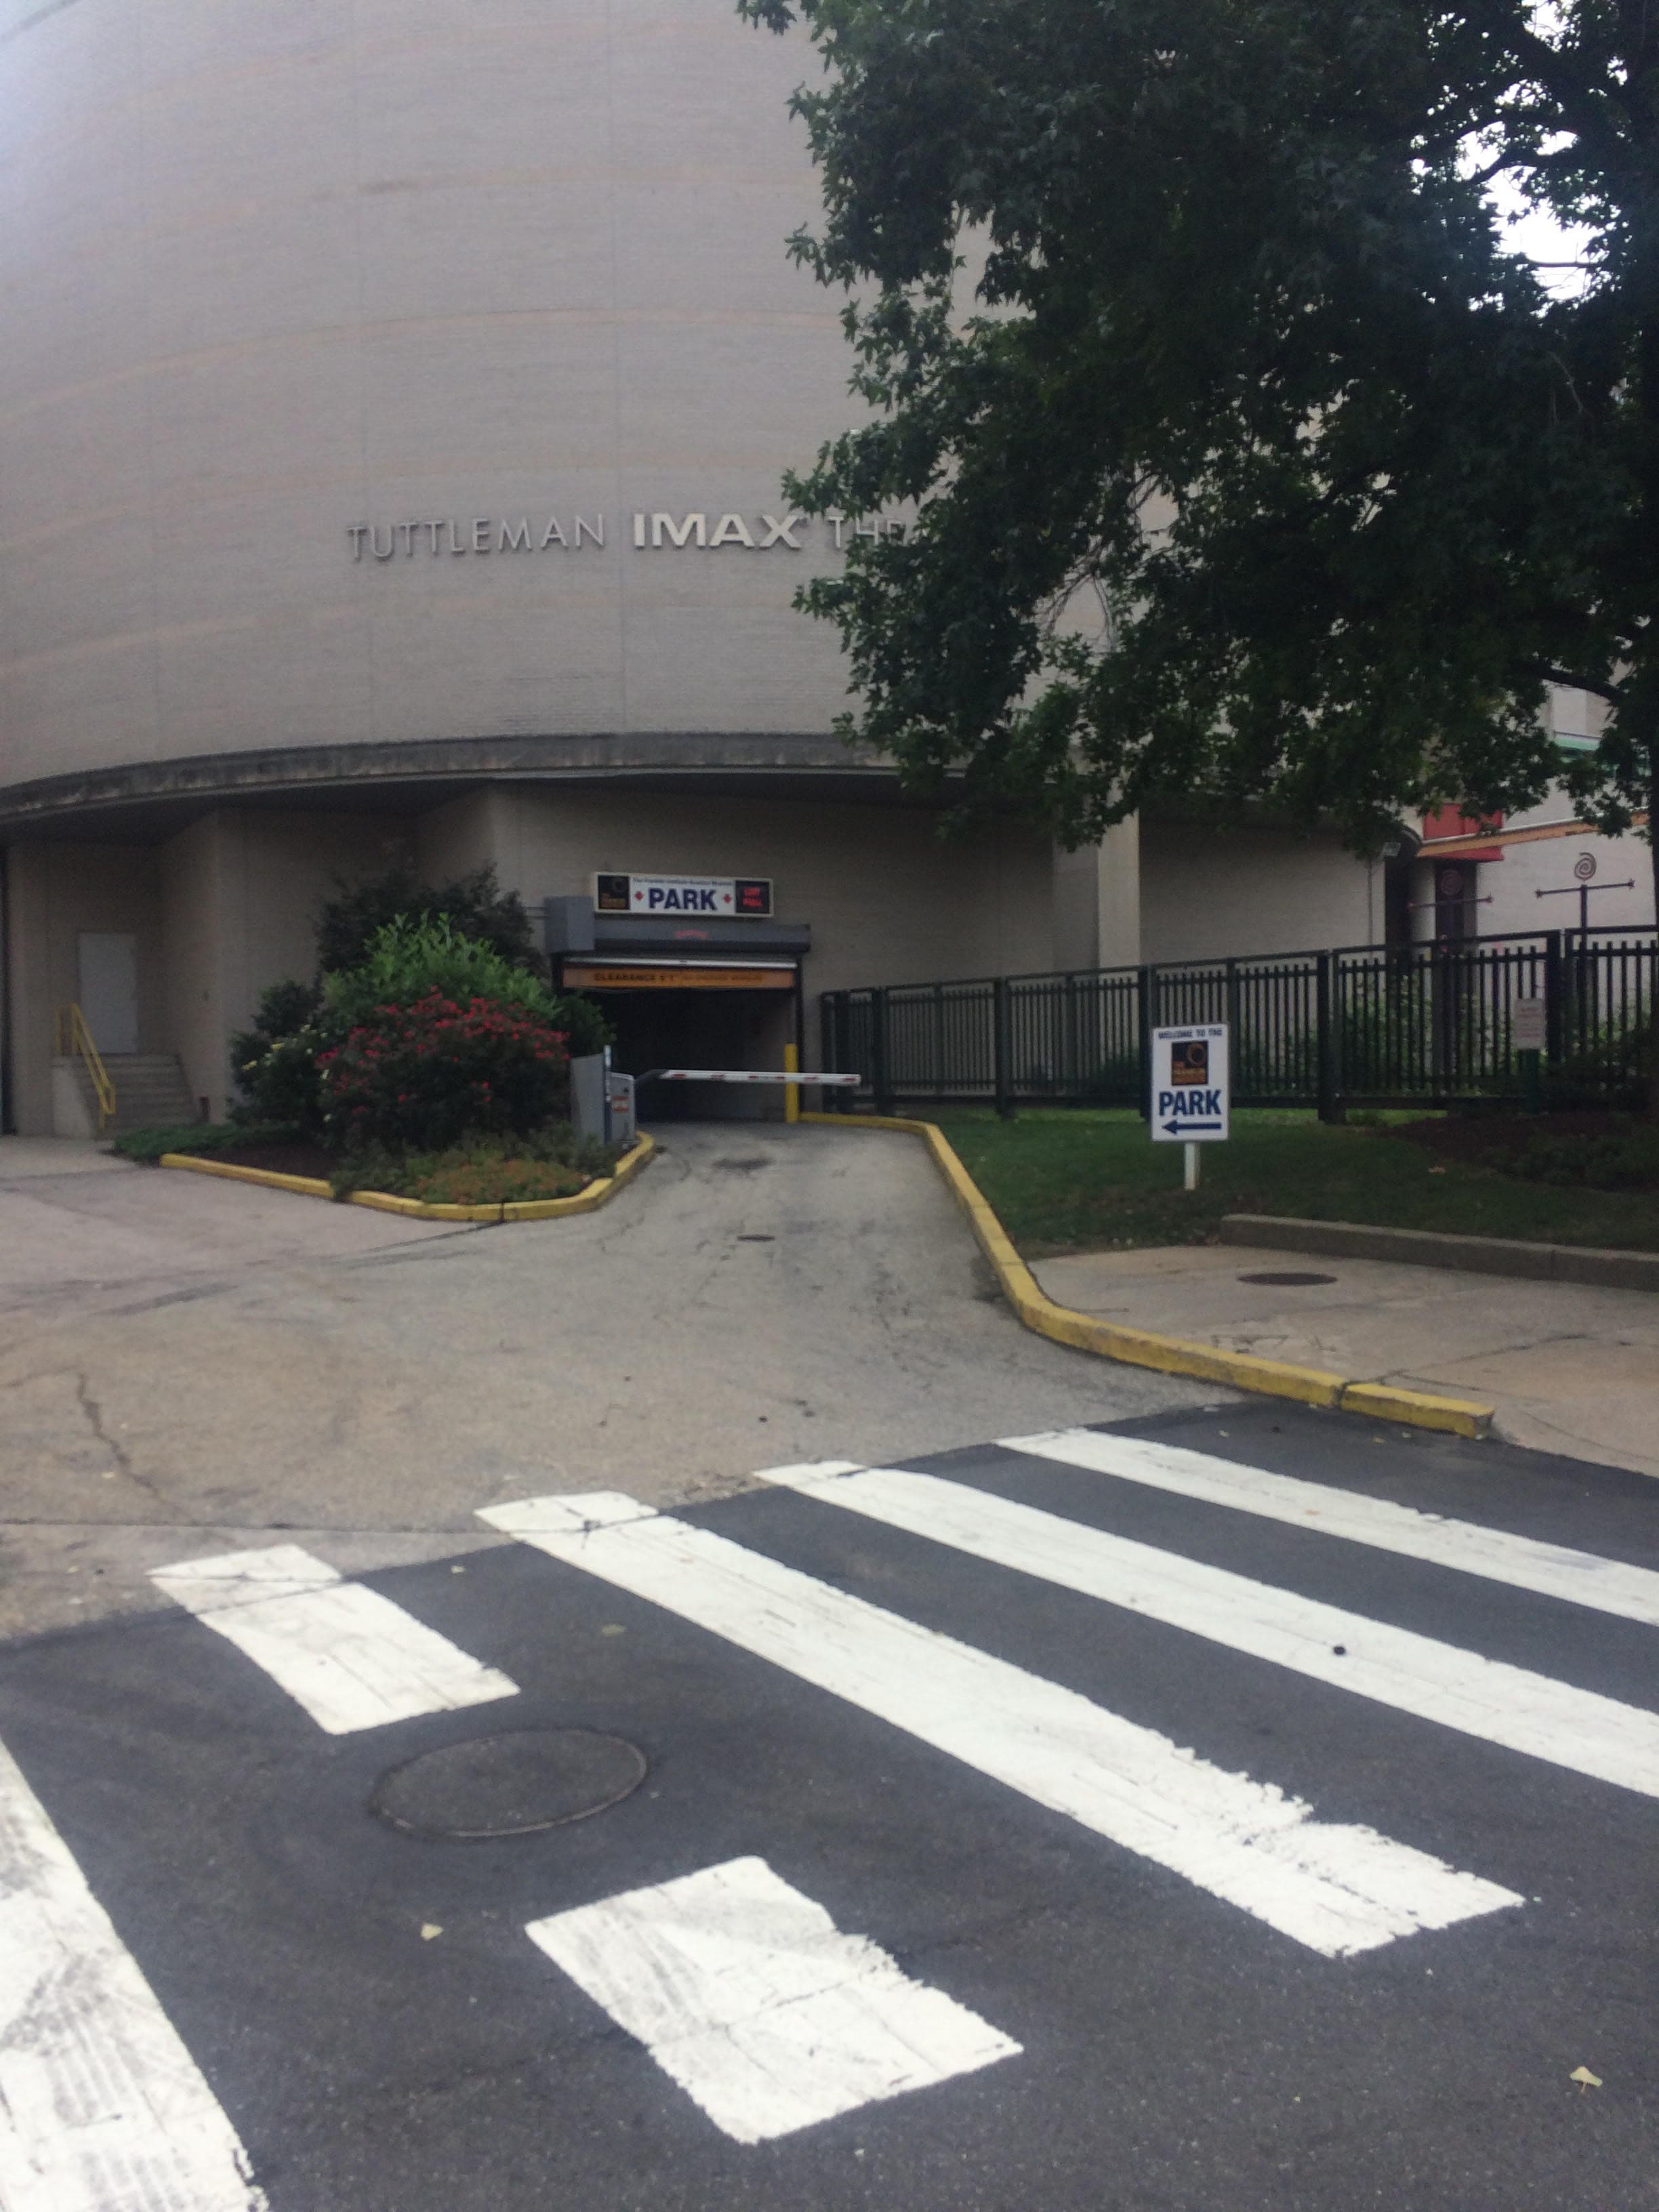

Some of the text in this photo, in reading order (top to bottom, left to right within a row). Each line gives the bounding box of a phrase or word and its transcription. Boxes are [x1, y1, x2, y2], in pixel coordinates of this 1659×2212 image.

[348, 514, 605, 561] TUTTLEMAN
[632, 512, 801, 548] IMAX
[648, 888, 718, 911] PARK
[1159, 1089, 1221, 1115] PARK
